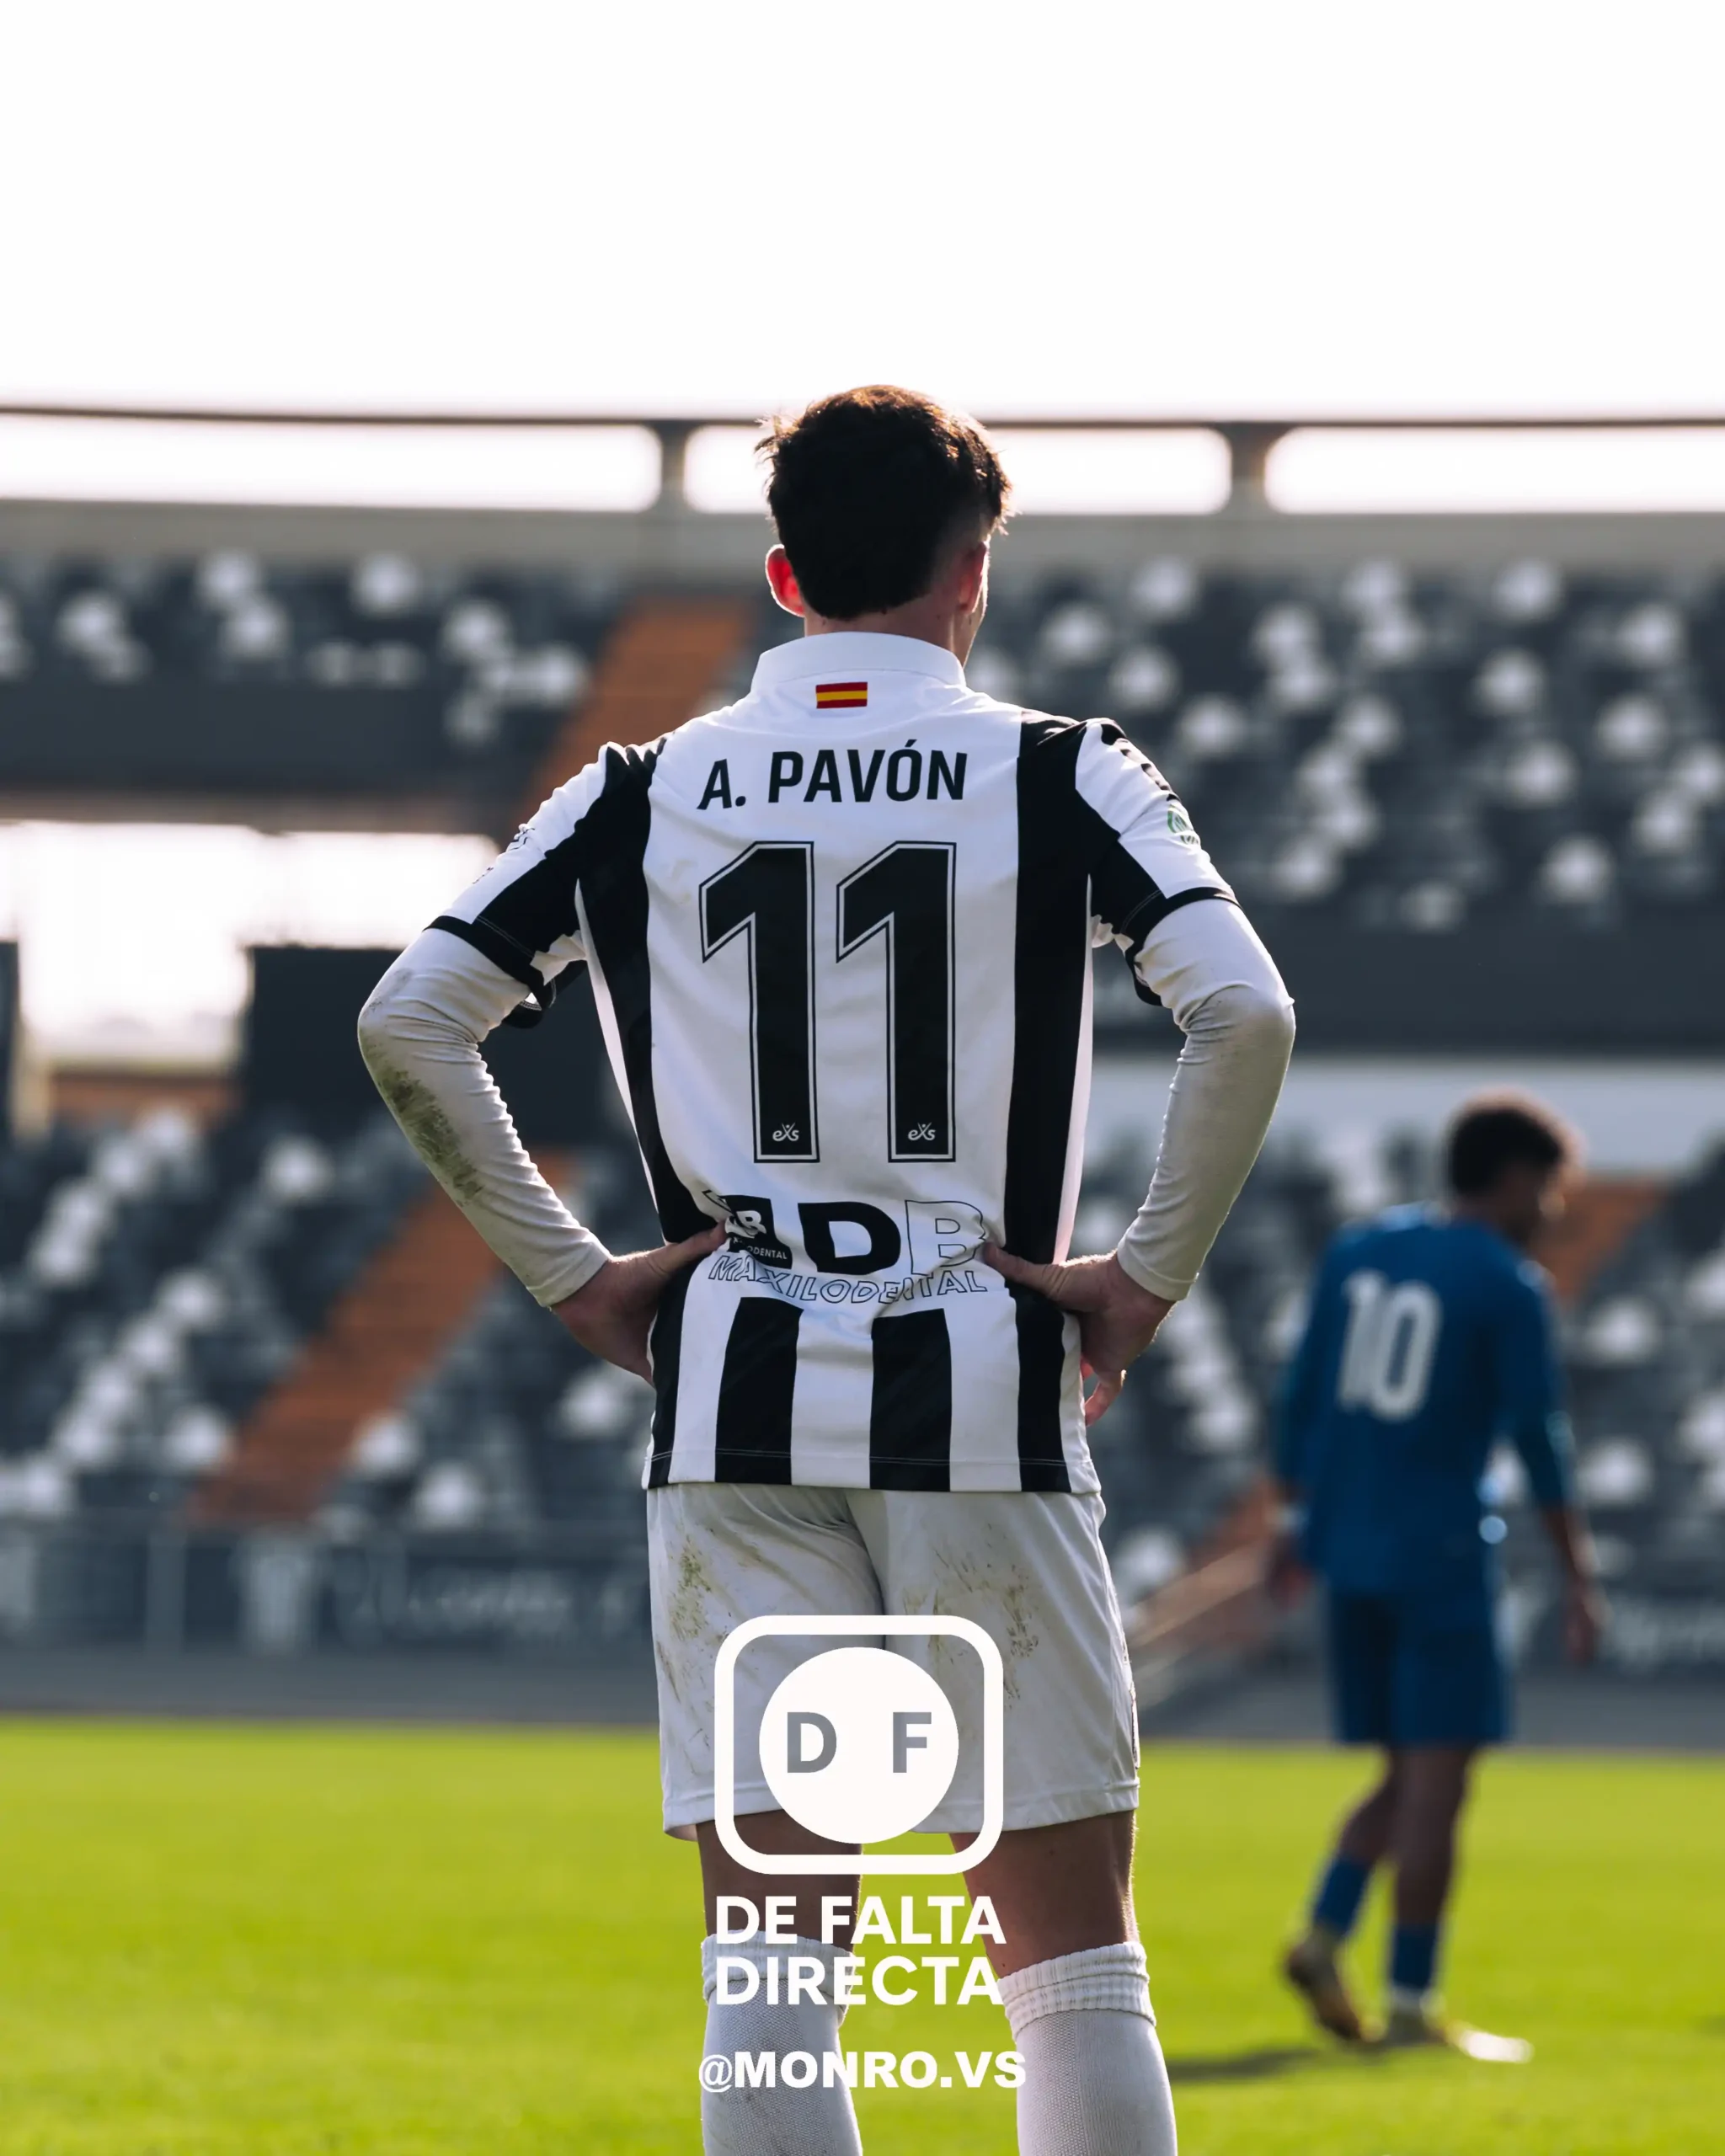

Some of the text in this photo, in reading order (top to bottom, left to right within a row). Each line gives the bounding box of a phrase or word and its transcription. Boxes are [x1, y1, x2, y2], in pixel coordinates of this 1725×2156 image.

[697, 739, 967, 809] A. PAVÓN
[698, 841, 956, 1163] 11
[1338, 1269, 1441, 1420] 10
